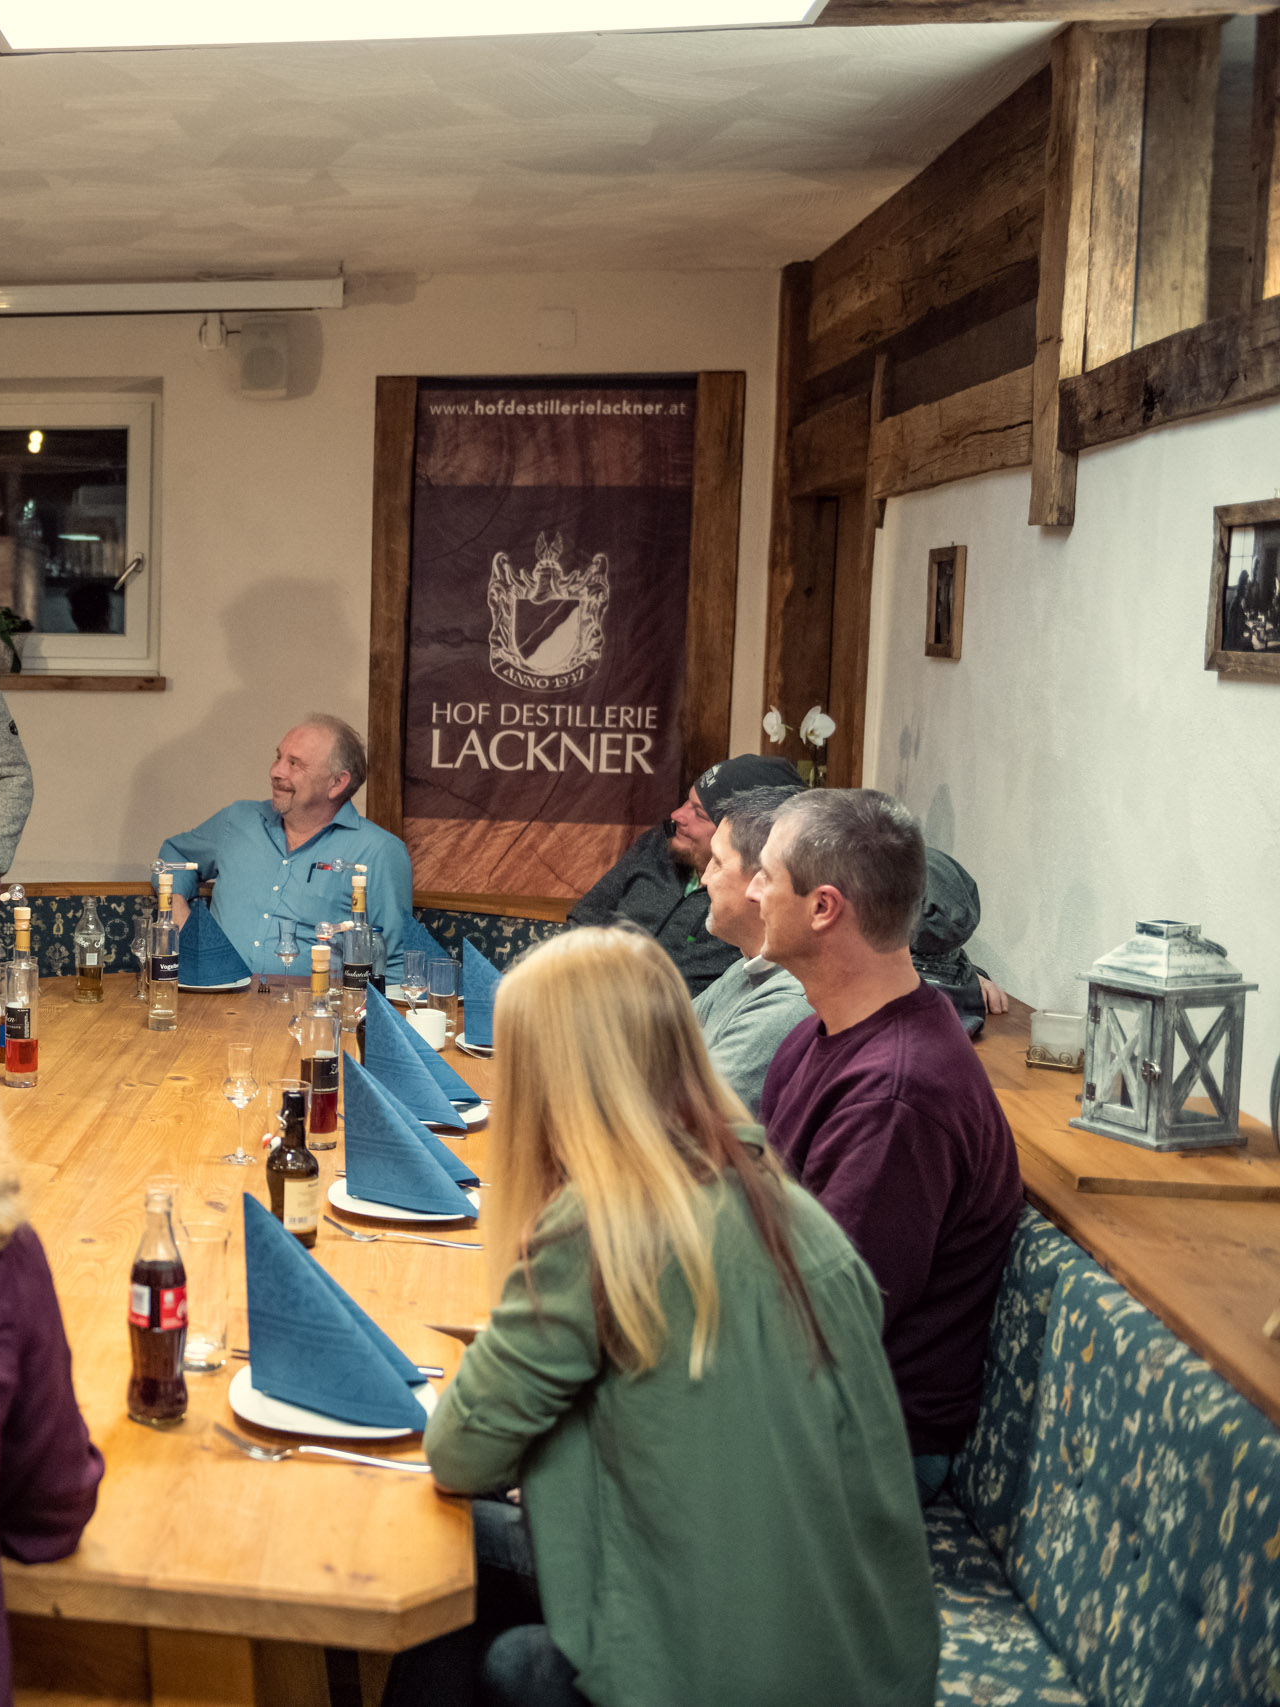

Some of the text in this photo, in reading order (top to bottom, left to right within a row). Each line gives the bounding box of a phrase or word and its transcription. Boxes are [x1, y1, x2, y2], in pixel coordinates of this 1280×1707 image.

[429, 399, 687, 416] www.hofdestillerielackner.at
[503, 667, 584, 689] ANNO 1937
[431, 701, 659, 729] HOF DESTILLERIE
[430, 729, 654, 775] LACKNER
